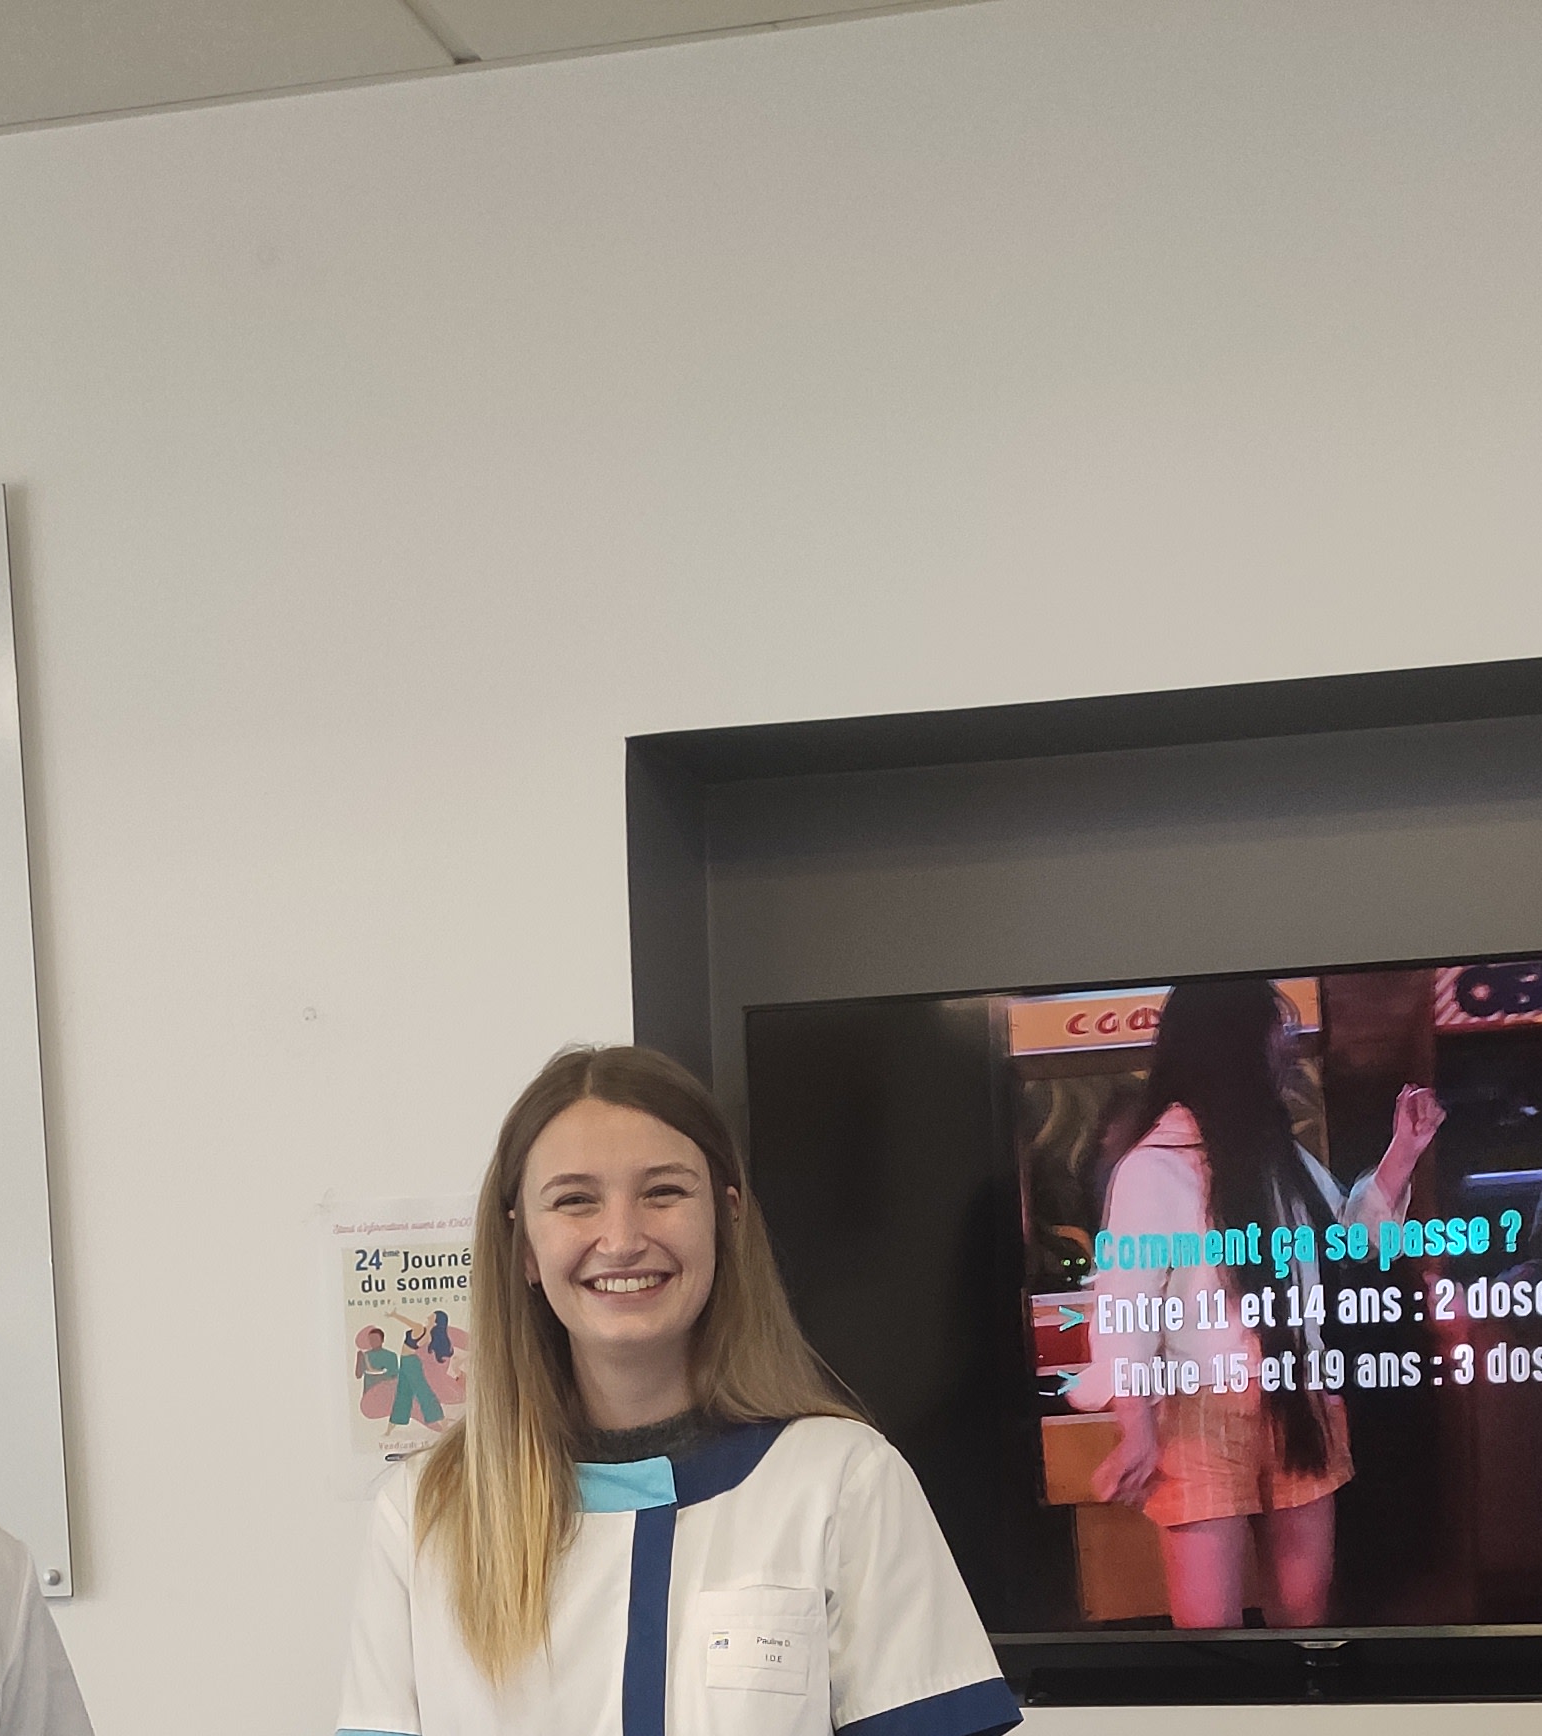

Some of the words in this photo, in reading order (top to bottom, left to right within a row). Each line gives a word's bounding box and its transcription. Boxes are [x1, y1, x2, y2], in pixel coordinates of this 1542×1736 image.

[401, 1248, 471, 1273] Journé
[1094, 1222, 1263, 1272] Comment
[1271, 1224, 1315, 1280] ça
[1325, 1223, 1369, 1260] se
[1381, 1216, 1490, 1272] passe
[1499, 1209, 1523, 1254] ?
[361, 1274, 385, 1293] du
[397, 1275, 472, 1291] somme
[1097, 1286, 1184, 1335] Entre
[1196, 1288, 1228, 1331] 11
[1241, 1286, 1277, 1328] et
[1287, 1284, 1326, 1326] 14
[1337, 1284, 1403, 1326] ans
[1413, 1290, 1423, 1322] :
[1435, 1278, 1455, 1322] 2
[1113, 1356, 1201, 1399] Entre
[1211, 1352, 1250, 1396] 15
[1260, 1350, 1297, 1393] et
[1307, 1349, 1346, 1390] 19
[1357, 1349, 1421, 1388] ans
[1431, 1354, 1443, 1387] :
[1453, 1344, 1475, 1385] 3
